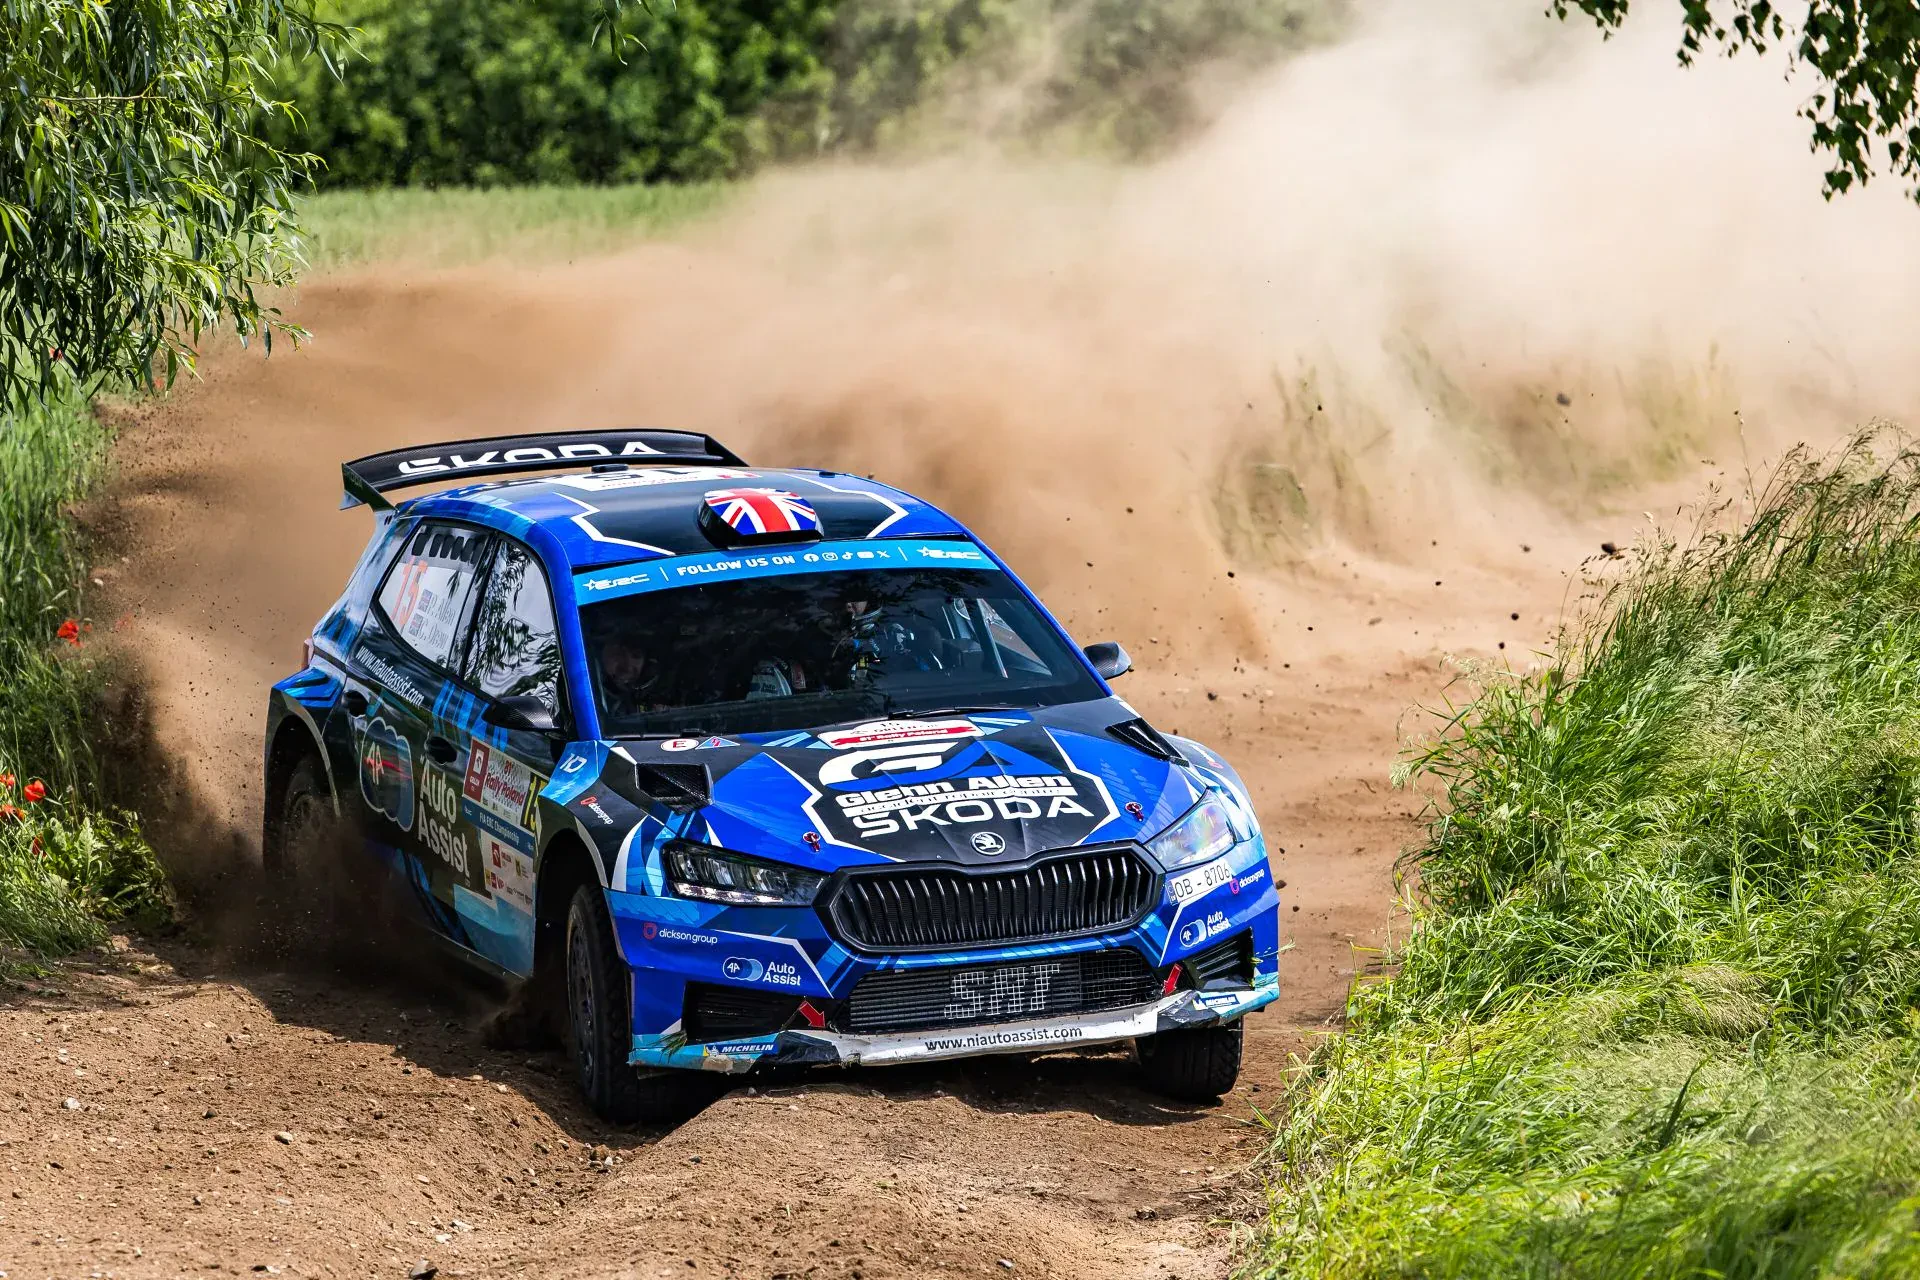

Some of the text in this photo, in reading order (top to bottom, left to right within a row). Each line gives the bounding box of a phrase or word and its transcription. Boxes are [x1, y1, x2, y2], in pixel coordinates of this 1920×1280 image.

[676, 555, 795, 576] FOLLOW US ON
[355, 645, 425, 708] www.niautoassist.com
[672, 739, 687, 748] E
[906, 729, 949, 737] Poland
[419, 760, 457, 824] Auto
[485, 772, 503, 797] Rally
[501, 783, 527, 805] Poland
[835, 775, 1072, 808] Glenn Allen
[418, 801, 470, 878] Assist
[479, 812, 487, 826] FIA
[486, 815, 494, 830] ERC
[494, 820, 520, 845] Championship
[1204, 863, 1231, 887] 8706
[1207, 910, 1223, 925] Auto
[1207, 918, 1232, 938] Assist
[762, 971, 802, 986] Assist
[767, 961, 795, 975] Auto
[721, 1043, 774, 1053] MICHELIN
[924, 1026, 1083, 1051] www.niautoassist.com
